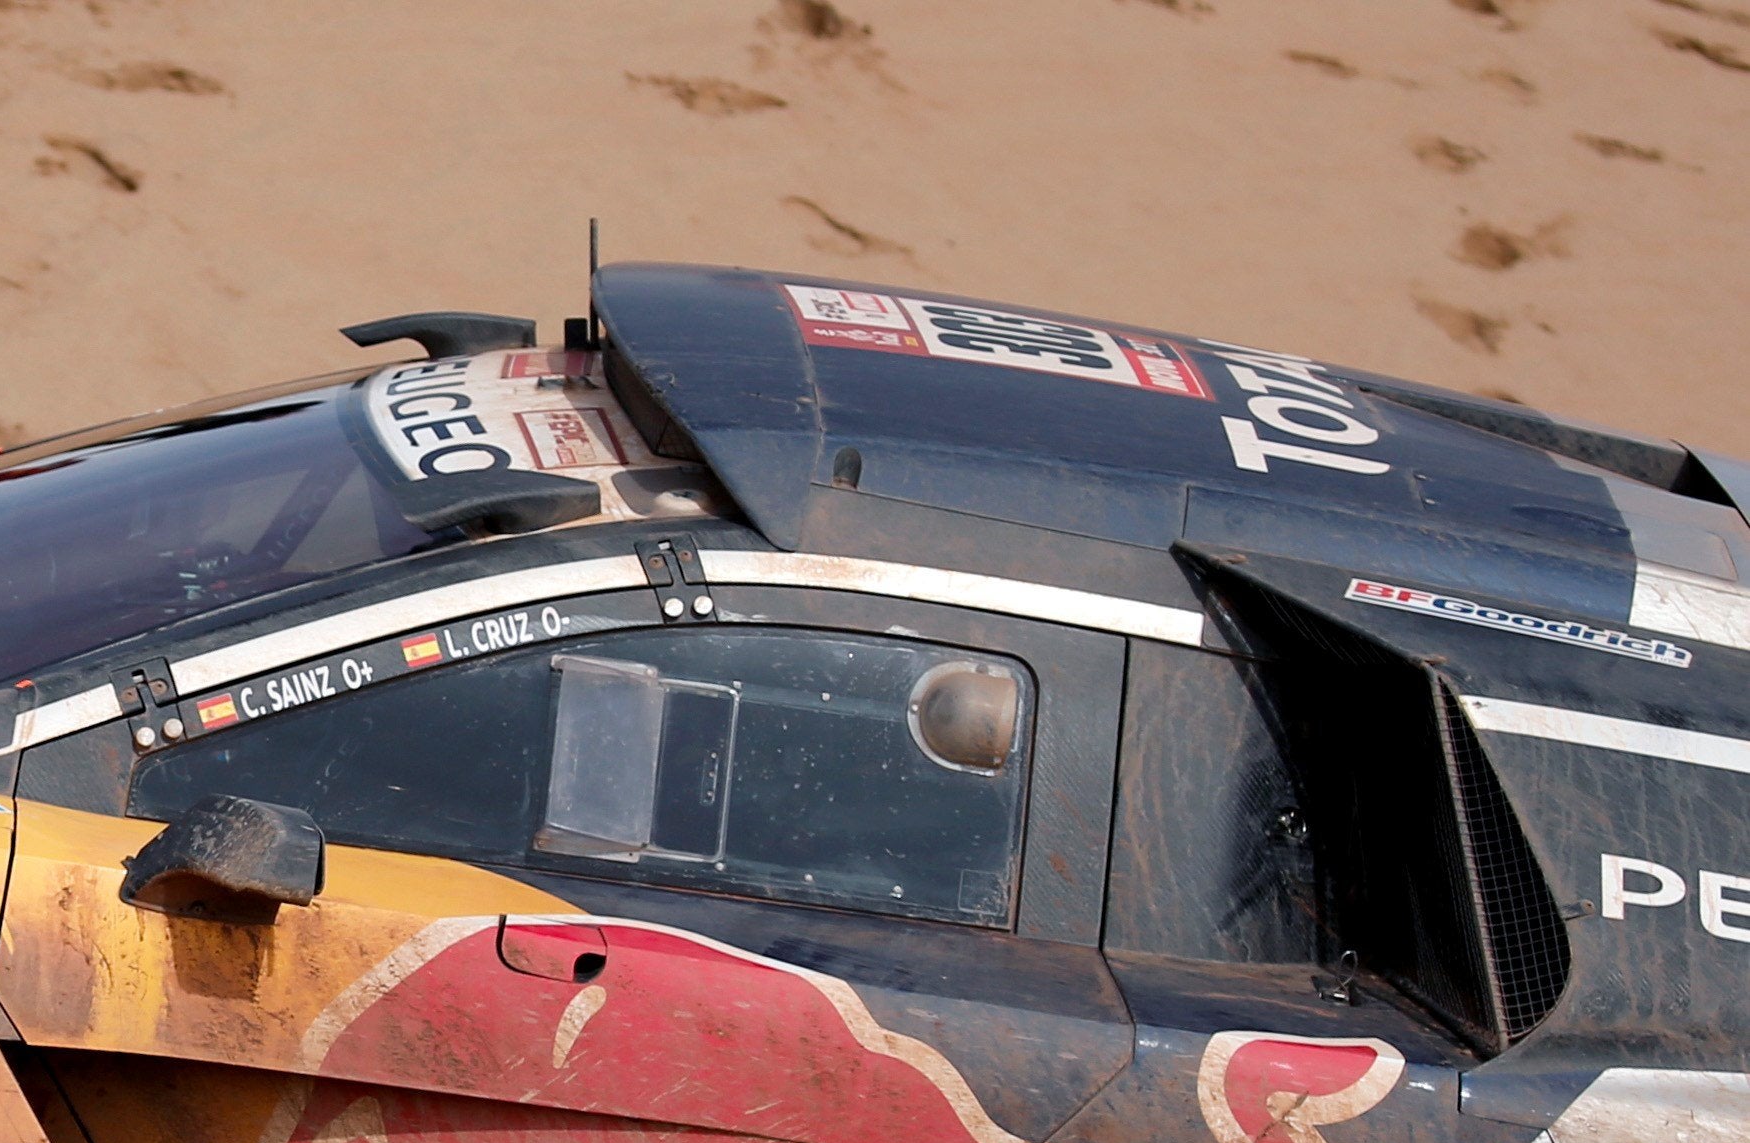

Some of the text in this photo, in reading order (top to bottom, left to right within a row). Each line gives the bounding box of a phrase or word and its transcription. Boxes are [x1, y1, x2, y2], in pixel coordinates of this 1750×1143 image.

[922, 305, 1113, 369] 303
[444, 629, 470, 659] L.
[471, 611, 535, 653] CRUZ
[1353, 581, 1688, 662] BFGoodrich
[241, 687, 267, 719] C.
[266, 665, 337, 713] SAINZ
